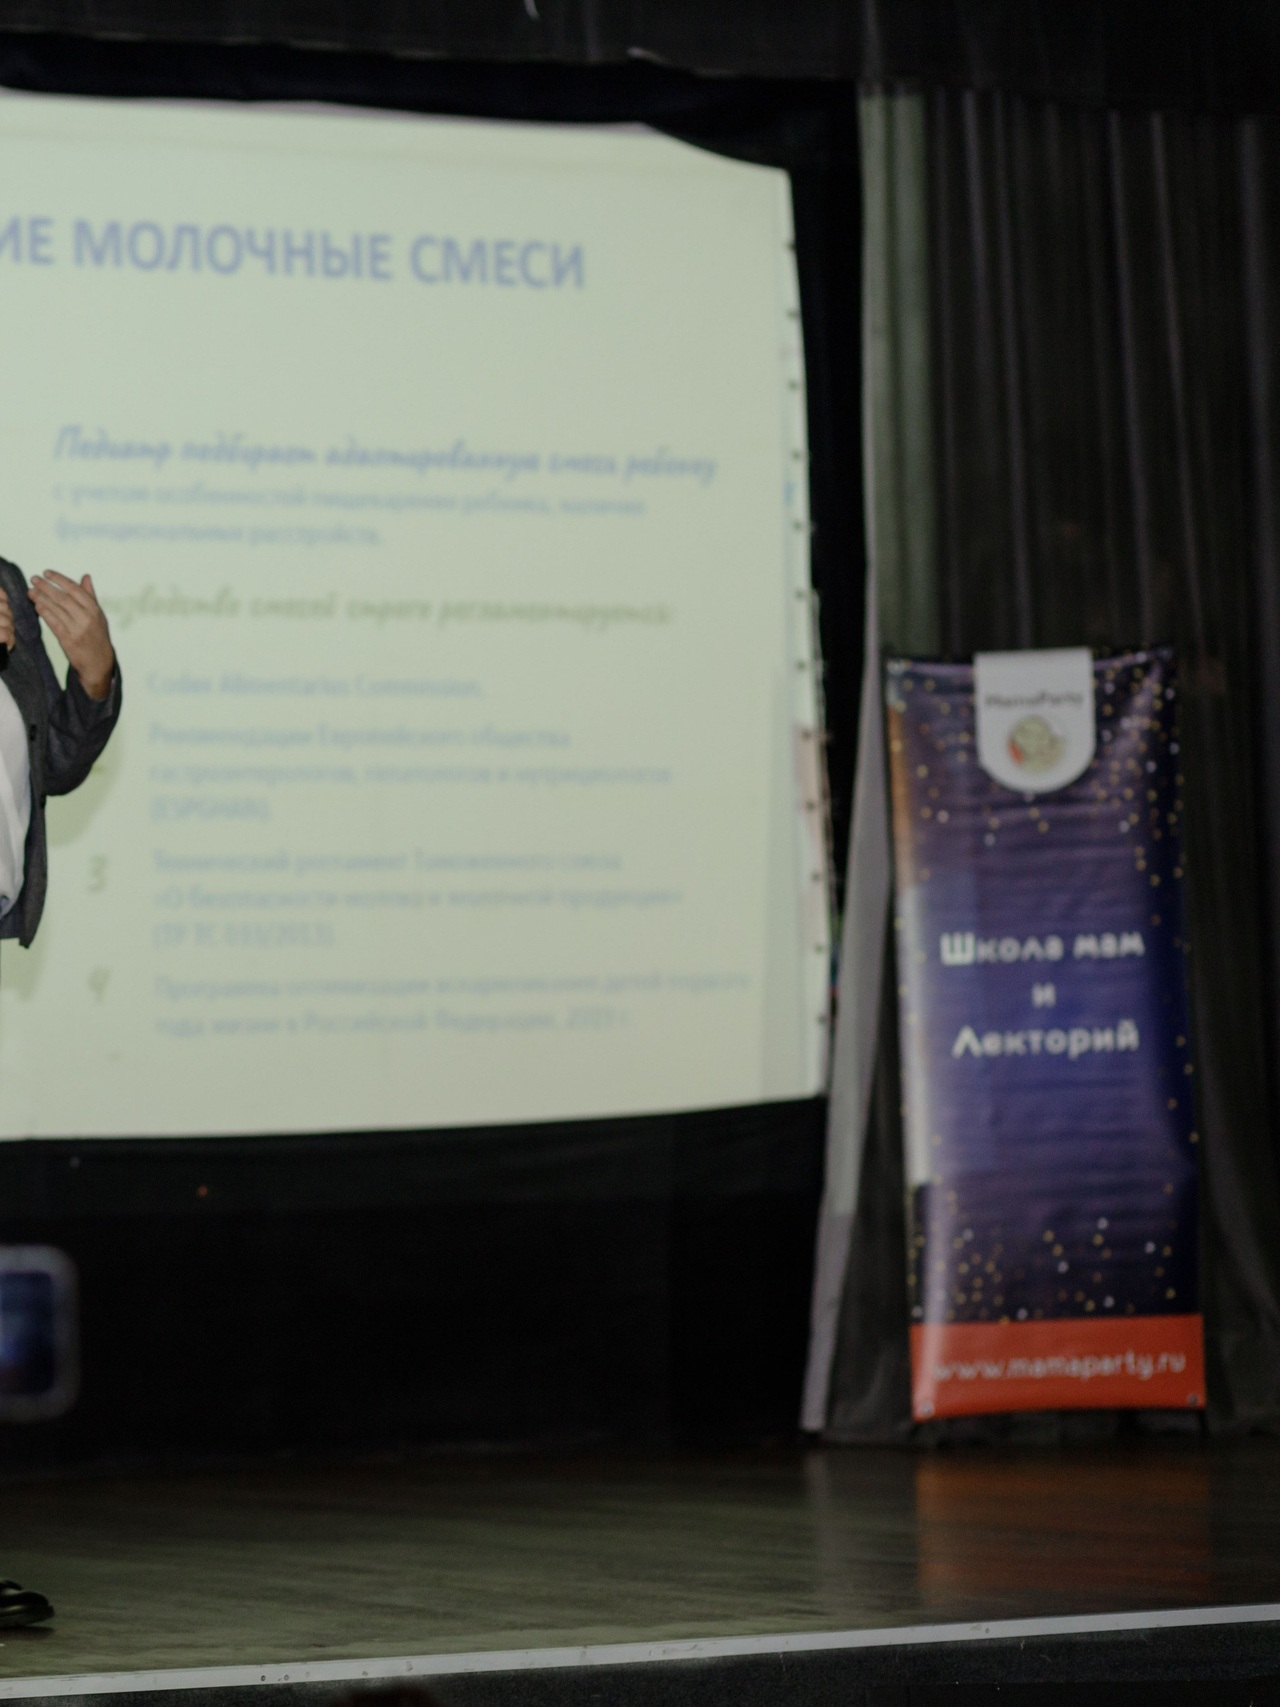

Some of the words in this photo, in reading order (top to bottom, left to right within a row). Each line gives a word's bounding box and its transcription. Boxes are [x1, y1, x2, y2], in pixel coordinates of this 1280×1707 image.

[74, 219, 393, 281] МОЛОЧНЫЕ
[410, 235, 586, 289] СМЕСИ
[54, 423, 174, 468] Педиатр
[180, 431, 317, 470] подбирает
[324, 434, 541, 482] адаптированную
[941, 931, 1063, 965] Школа
[1073, 931, 1144, 959] мам
[1032, 984, 1056, 1008] и
[952, 1018, 1139, 1058] Лекторий
